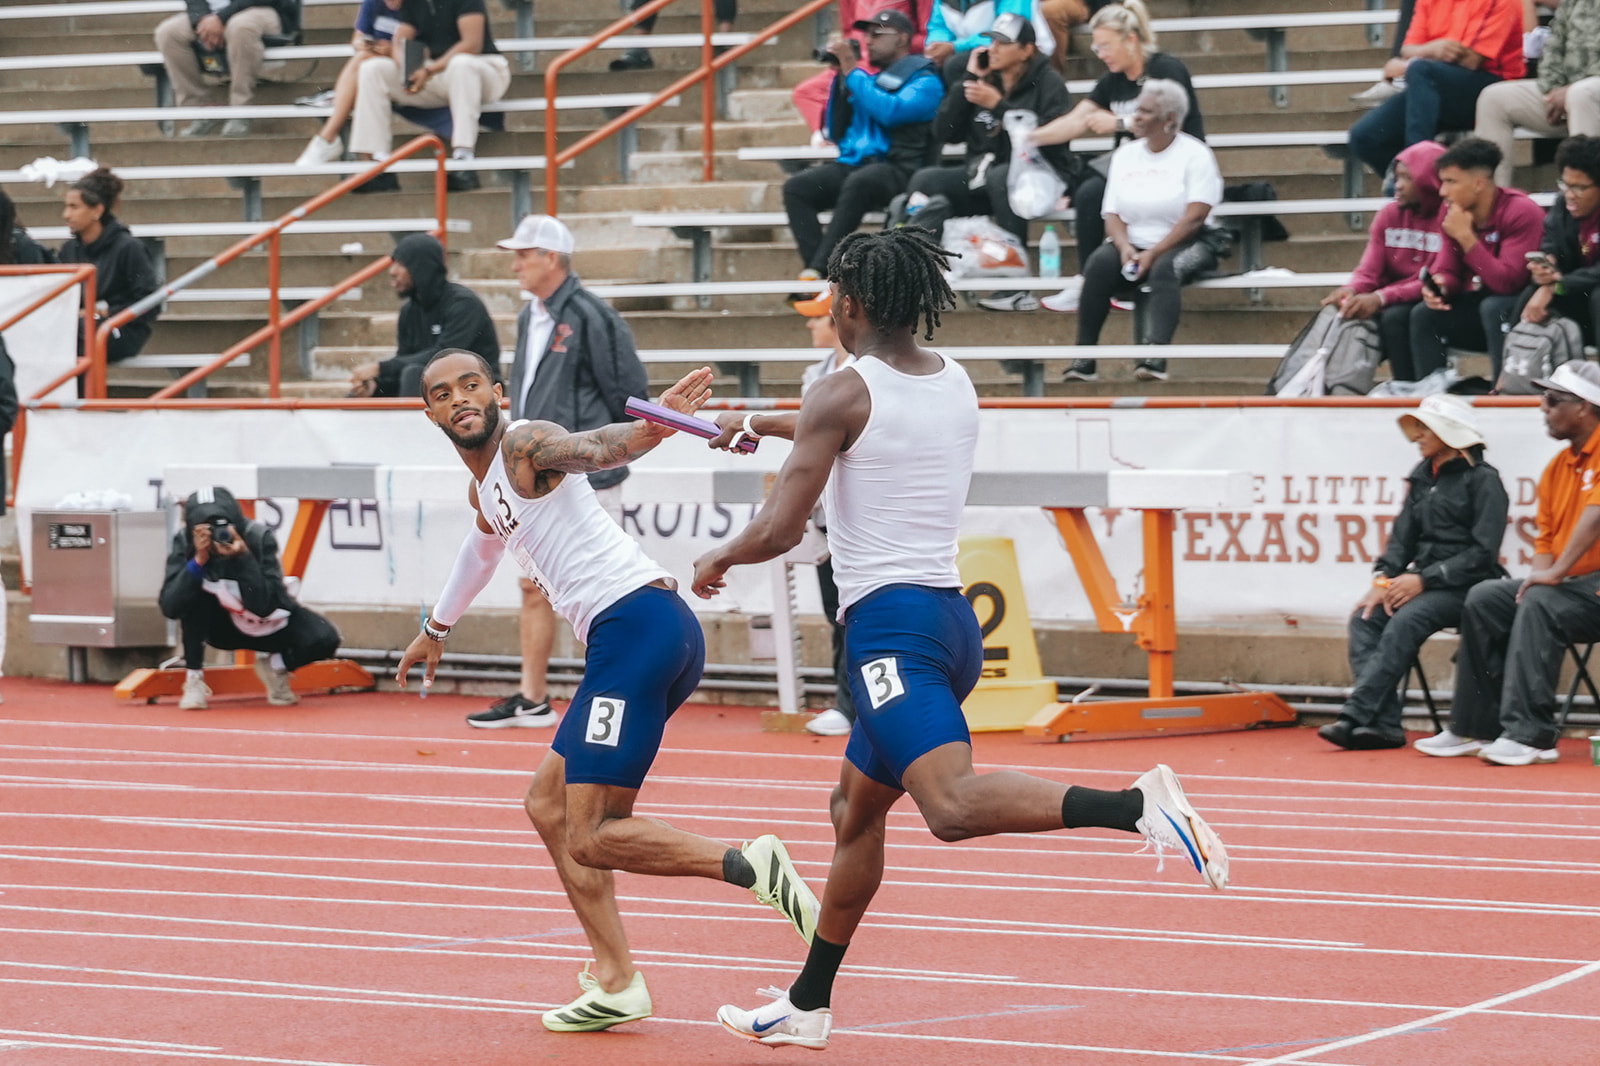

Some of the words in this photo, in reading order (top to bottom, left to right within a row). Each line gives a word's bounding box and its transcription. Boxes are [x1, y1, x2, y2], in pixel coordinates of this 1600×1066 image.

[1282, 476, 1408, 505] LITTL
[1172, 512, 1322, 563] EXAS
[964, 582, 1008, 660] 2
[869, 662, 892, 703] 3
[592, 701, 615, 741] 3
